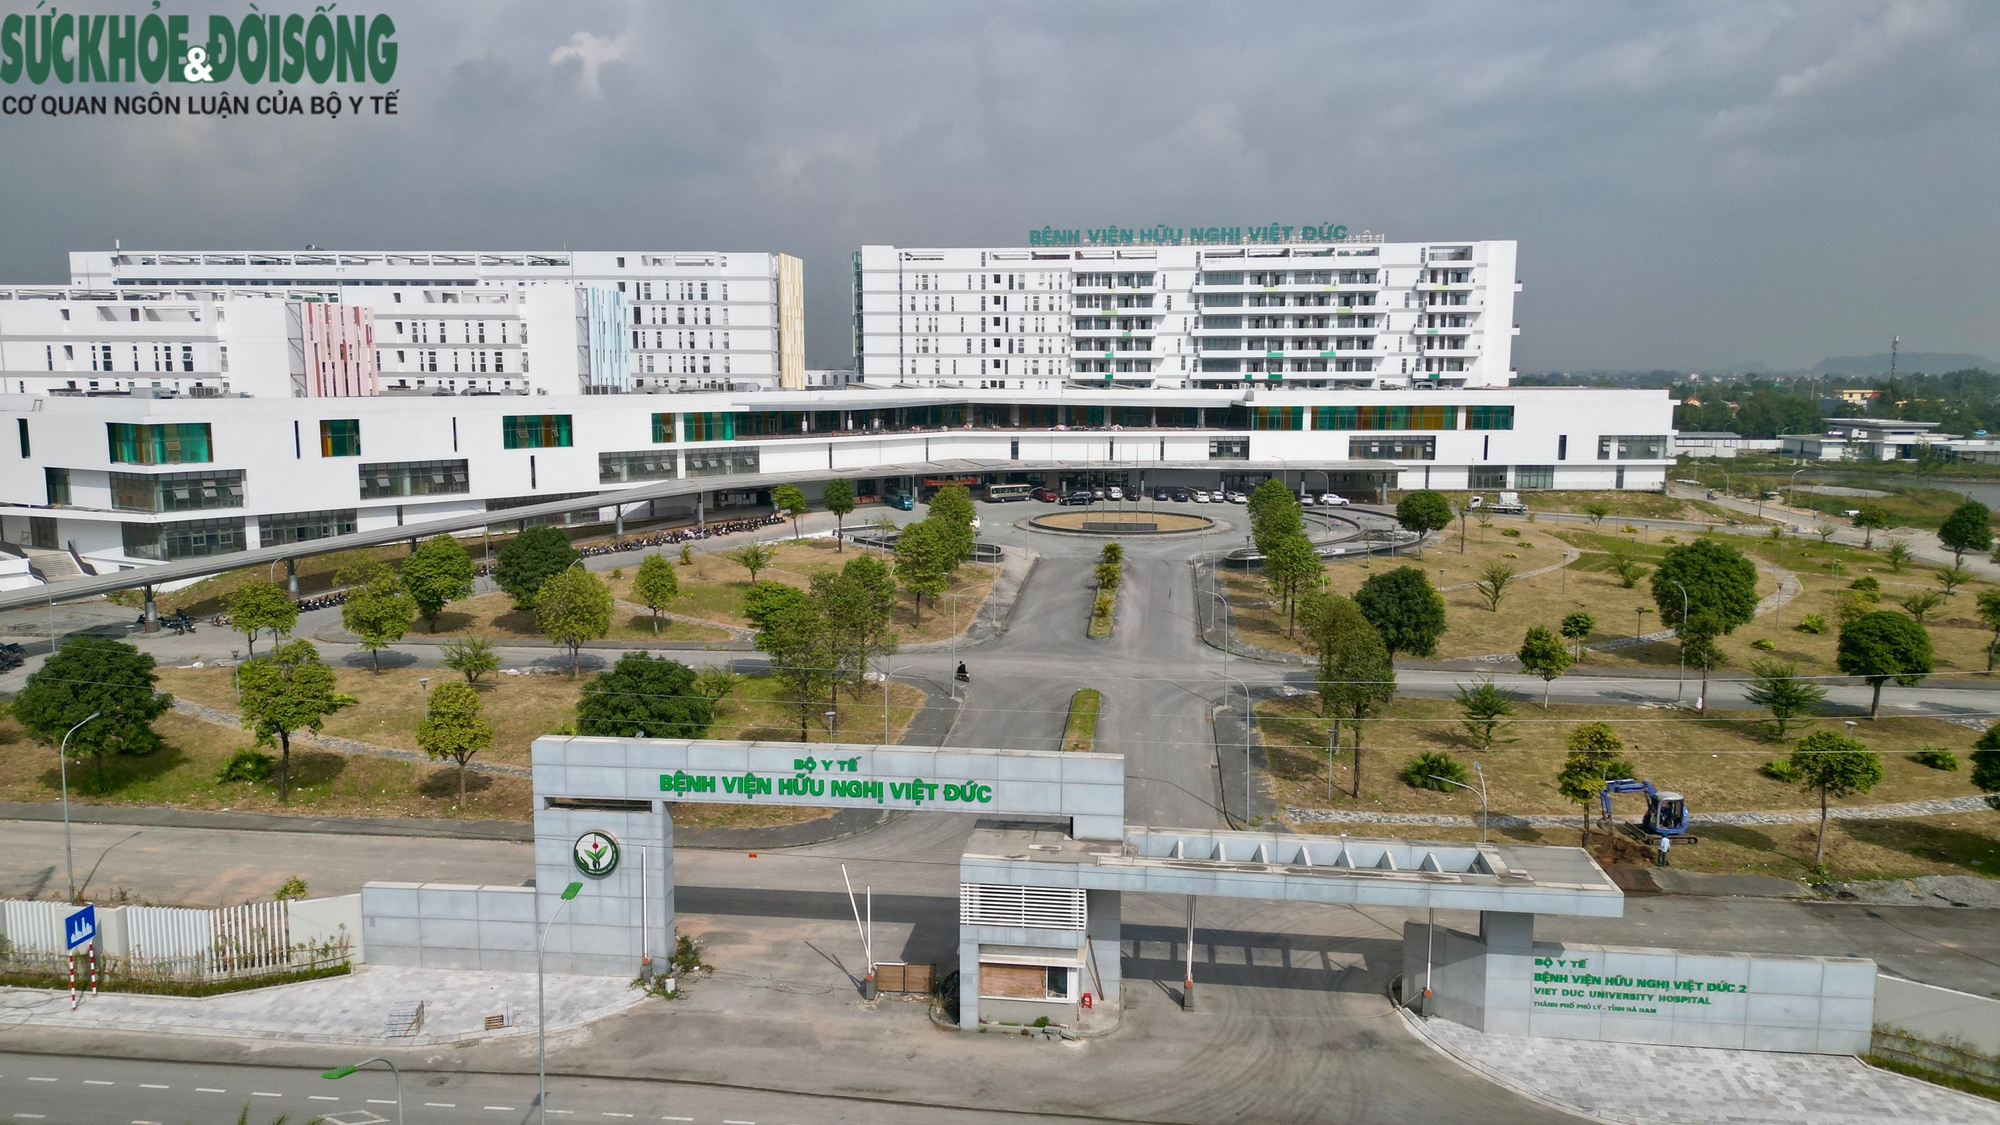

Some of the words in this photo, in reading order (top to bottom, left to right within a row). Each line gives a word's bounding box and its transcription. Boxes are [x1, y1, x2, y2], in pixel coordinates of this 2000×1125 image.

[1139, 224, 1183, 243] HỮU
[1302, 221, 1348, 240] ĐỨC
[793, 756, 817, 774] BỘ
[821, 760, 834, 771] Y
[837, 756, 862, 772] TẾ
[659, 769, 716, 797] BỆNH
[721, 771, 772, 799] VIỆN
[778, 773, 825, 797] HỮU
[831, 779, 884, 804] NGHỊ
[889, 778, 939, 805] VIỆT
[943, 778, 993, 803] ĐỨC
[1534, 957, 1554, 969] BỘ
[1557, 959, 1567, 968] Y
[1570, 958, 1589, 969] TẾ
[1533, 971, 1569, 985] BỆNH
[1571, 973, 1602, 987] VIỆN
[1604, 975, 1634, 988] HỮU
[1636, 978, 1671, 992] NGHỊ
[1673, 979, 1704, 993] VIỆT
[1706, 980, 1736, 993] ĐỨC
[1738, 984, 1748, 994] 2
[1533, 986, 1558, 996] VIET
[1561, 988, 1585, 998] DUC
[1588, 990, 1655, 1002] UNIVERSITY
[1658, 994, 1712, 1005] HOSPITAL
